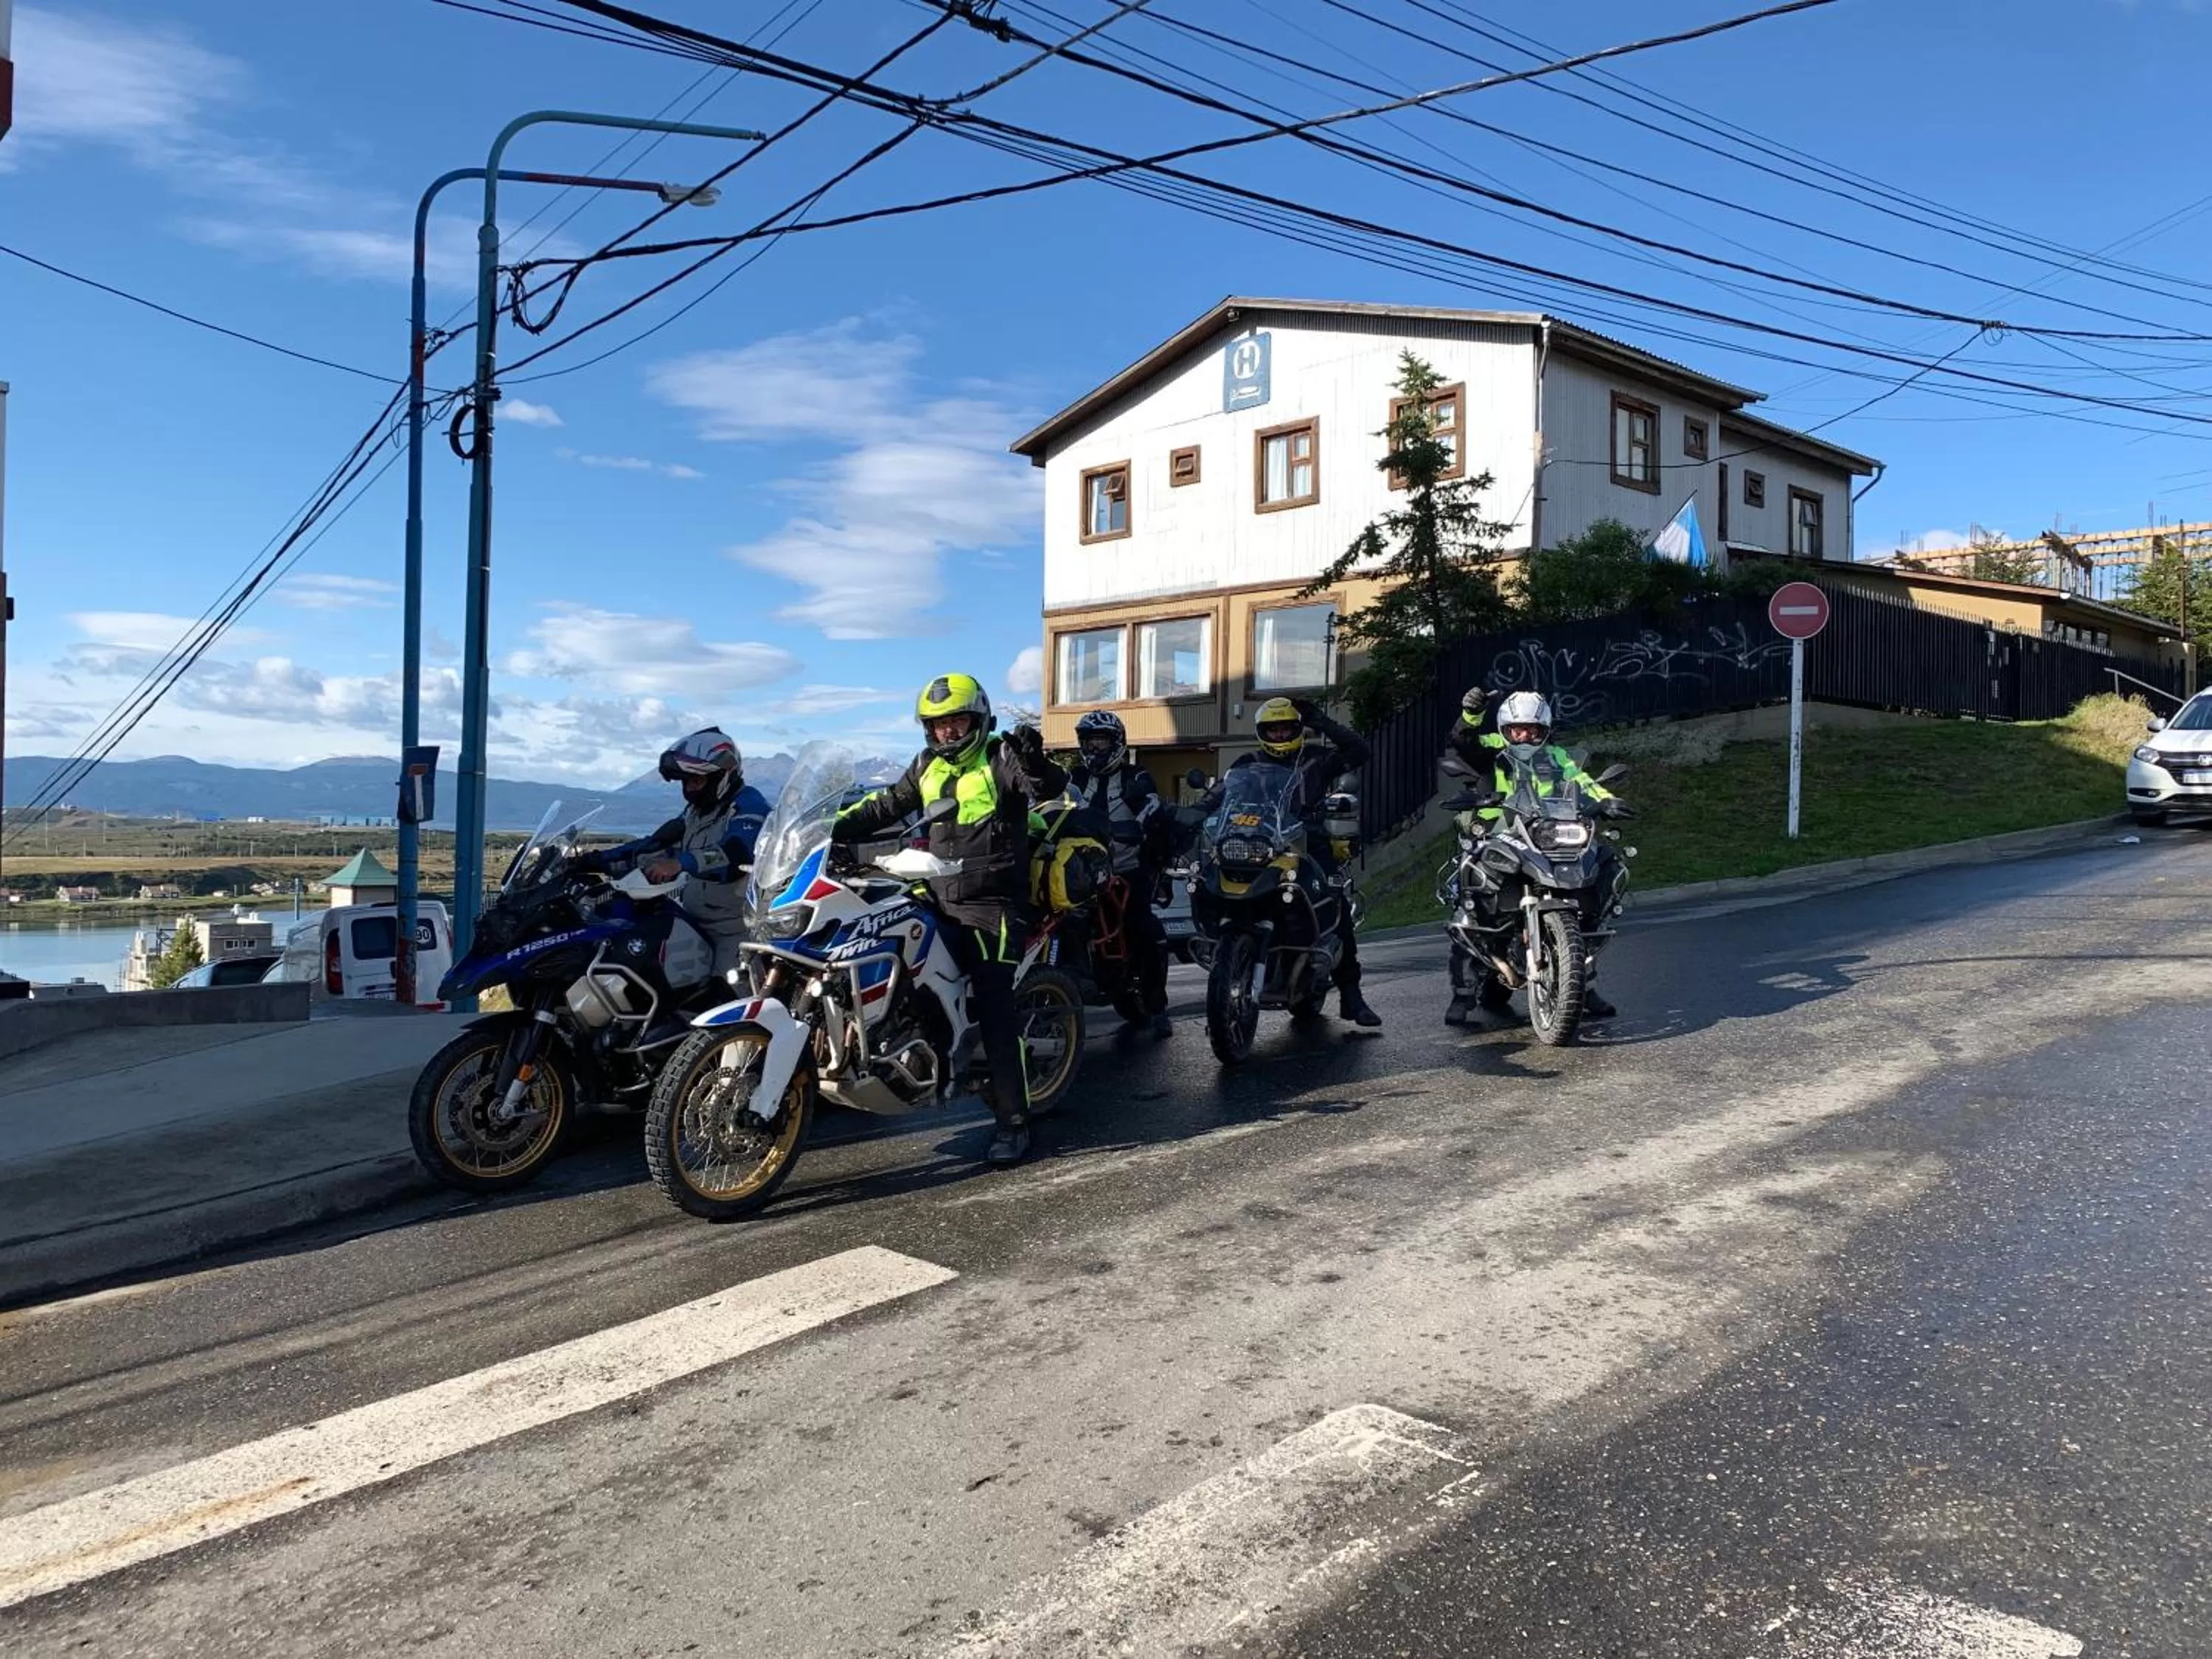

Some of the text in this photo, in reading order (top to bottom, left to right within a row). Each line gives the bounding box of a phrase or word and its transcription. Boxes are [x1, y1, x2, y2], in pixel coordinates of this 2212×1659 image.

[1237, 346, 1256, 376] H
[846, 904, 917, 942] Africa
[507, 932, 568, 960] R1250
[824, 937, 884, 961] Twin
